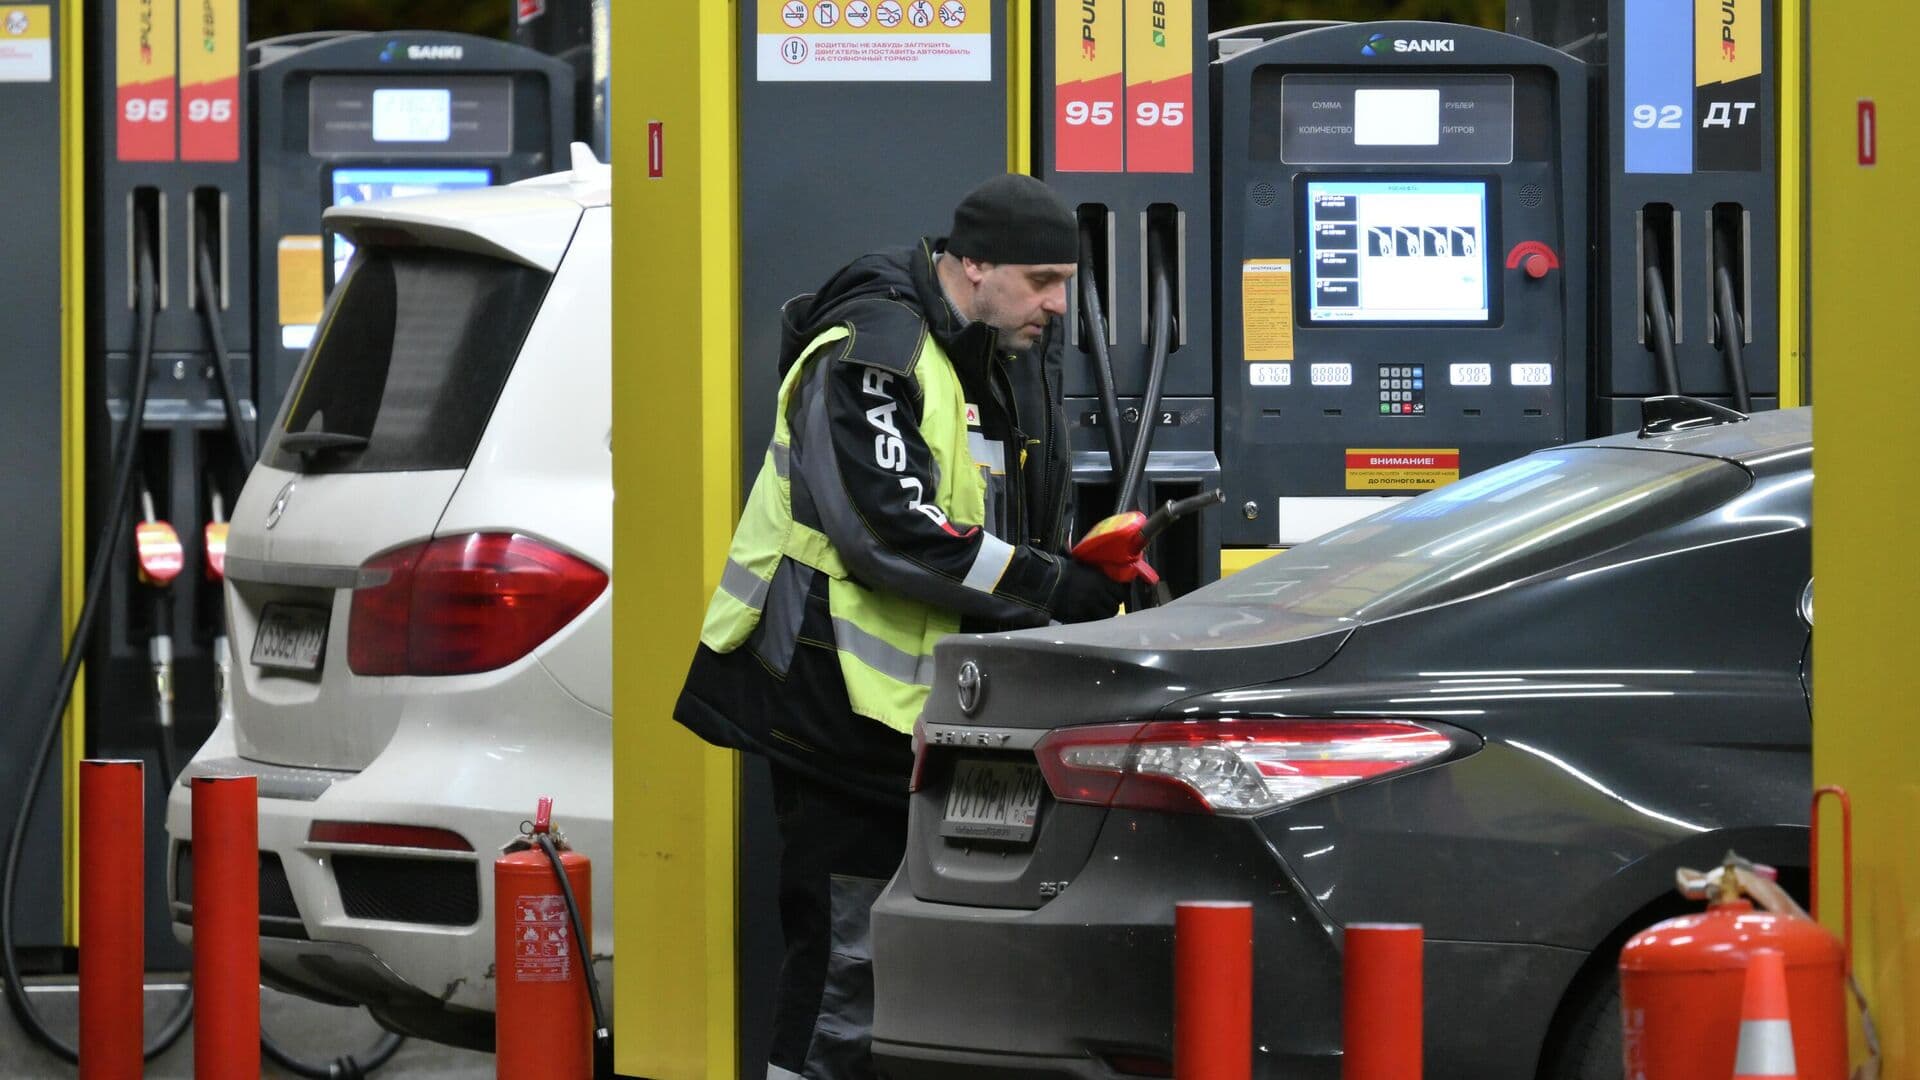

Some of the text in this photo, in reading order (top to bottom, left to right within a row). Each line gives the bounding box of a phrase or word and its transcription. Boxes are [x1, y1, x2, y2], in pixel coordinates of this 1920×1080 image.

[1393, 38, 1455, 52] SANKI
[407, 45, 464, 60] SANKI
[125, 99, 168, 122] 95
[188, 99, 232, 122] 95
[1312, 101, 1342, 110] СУММА
[1445, 101, 1475, 110] РУБЛЕЙ
[1065, 101, 1114, 126] 95
[1135, 102, 1185, 127] 95
[1632, 104, 1683, 129] 92
[1702, 102, 1756, 128] ДТ
[1298, 126, 1353, 136] КОЛИЧЕСТВО
[1442, 126, 1475, 136] ЛИТРОВ
[1089, 413, 1097, 424] 1
[1163, 413, 1172, 424] 2
[1370, 457, 1434, 465] ВНИМАНИЕ!
